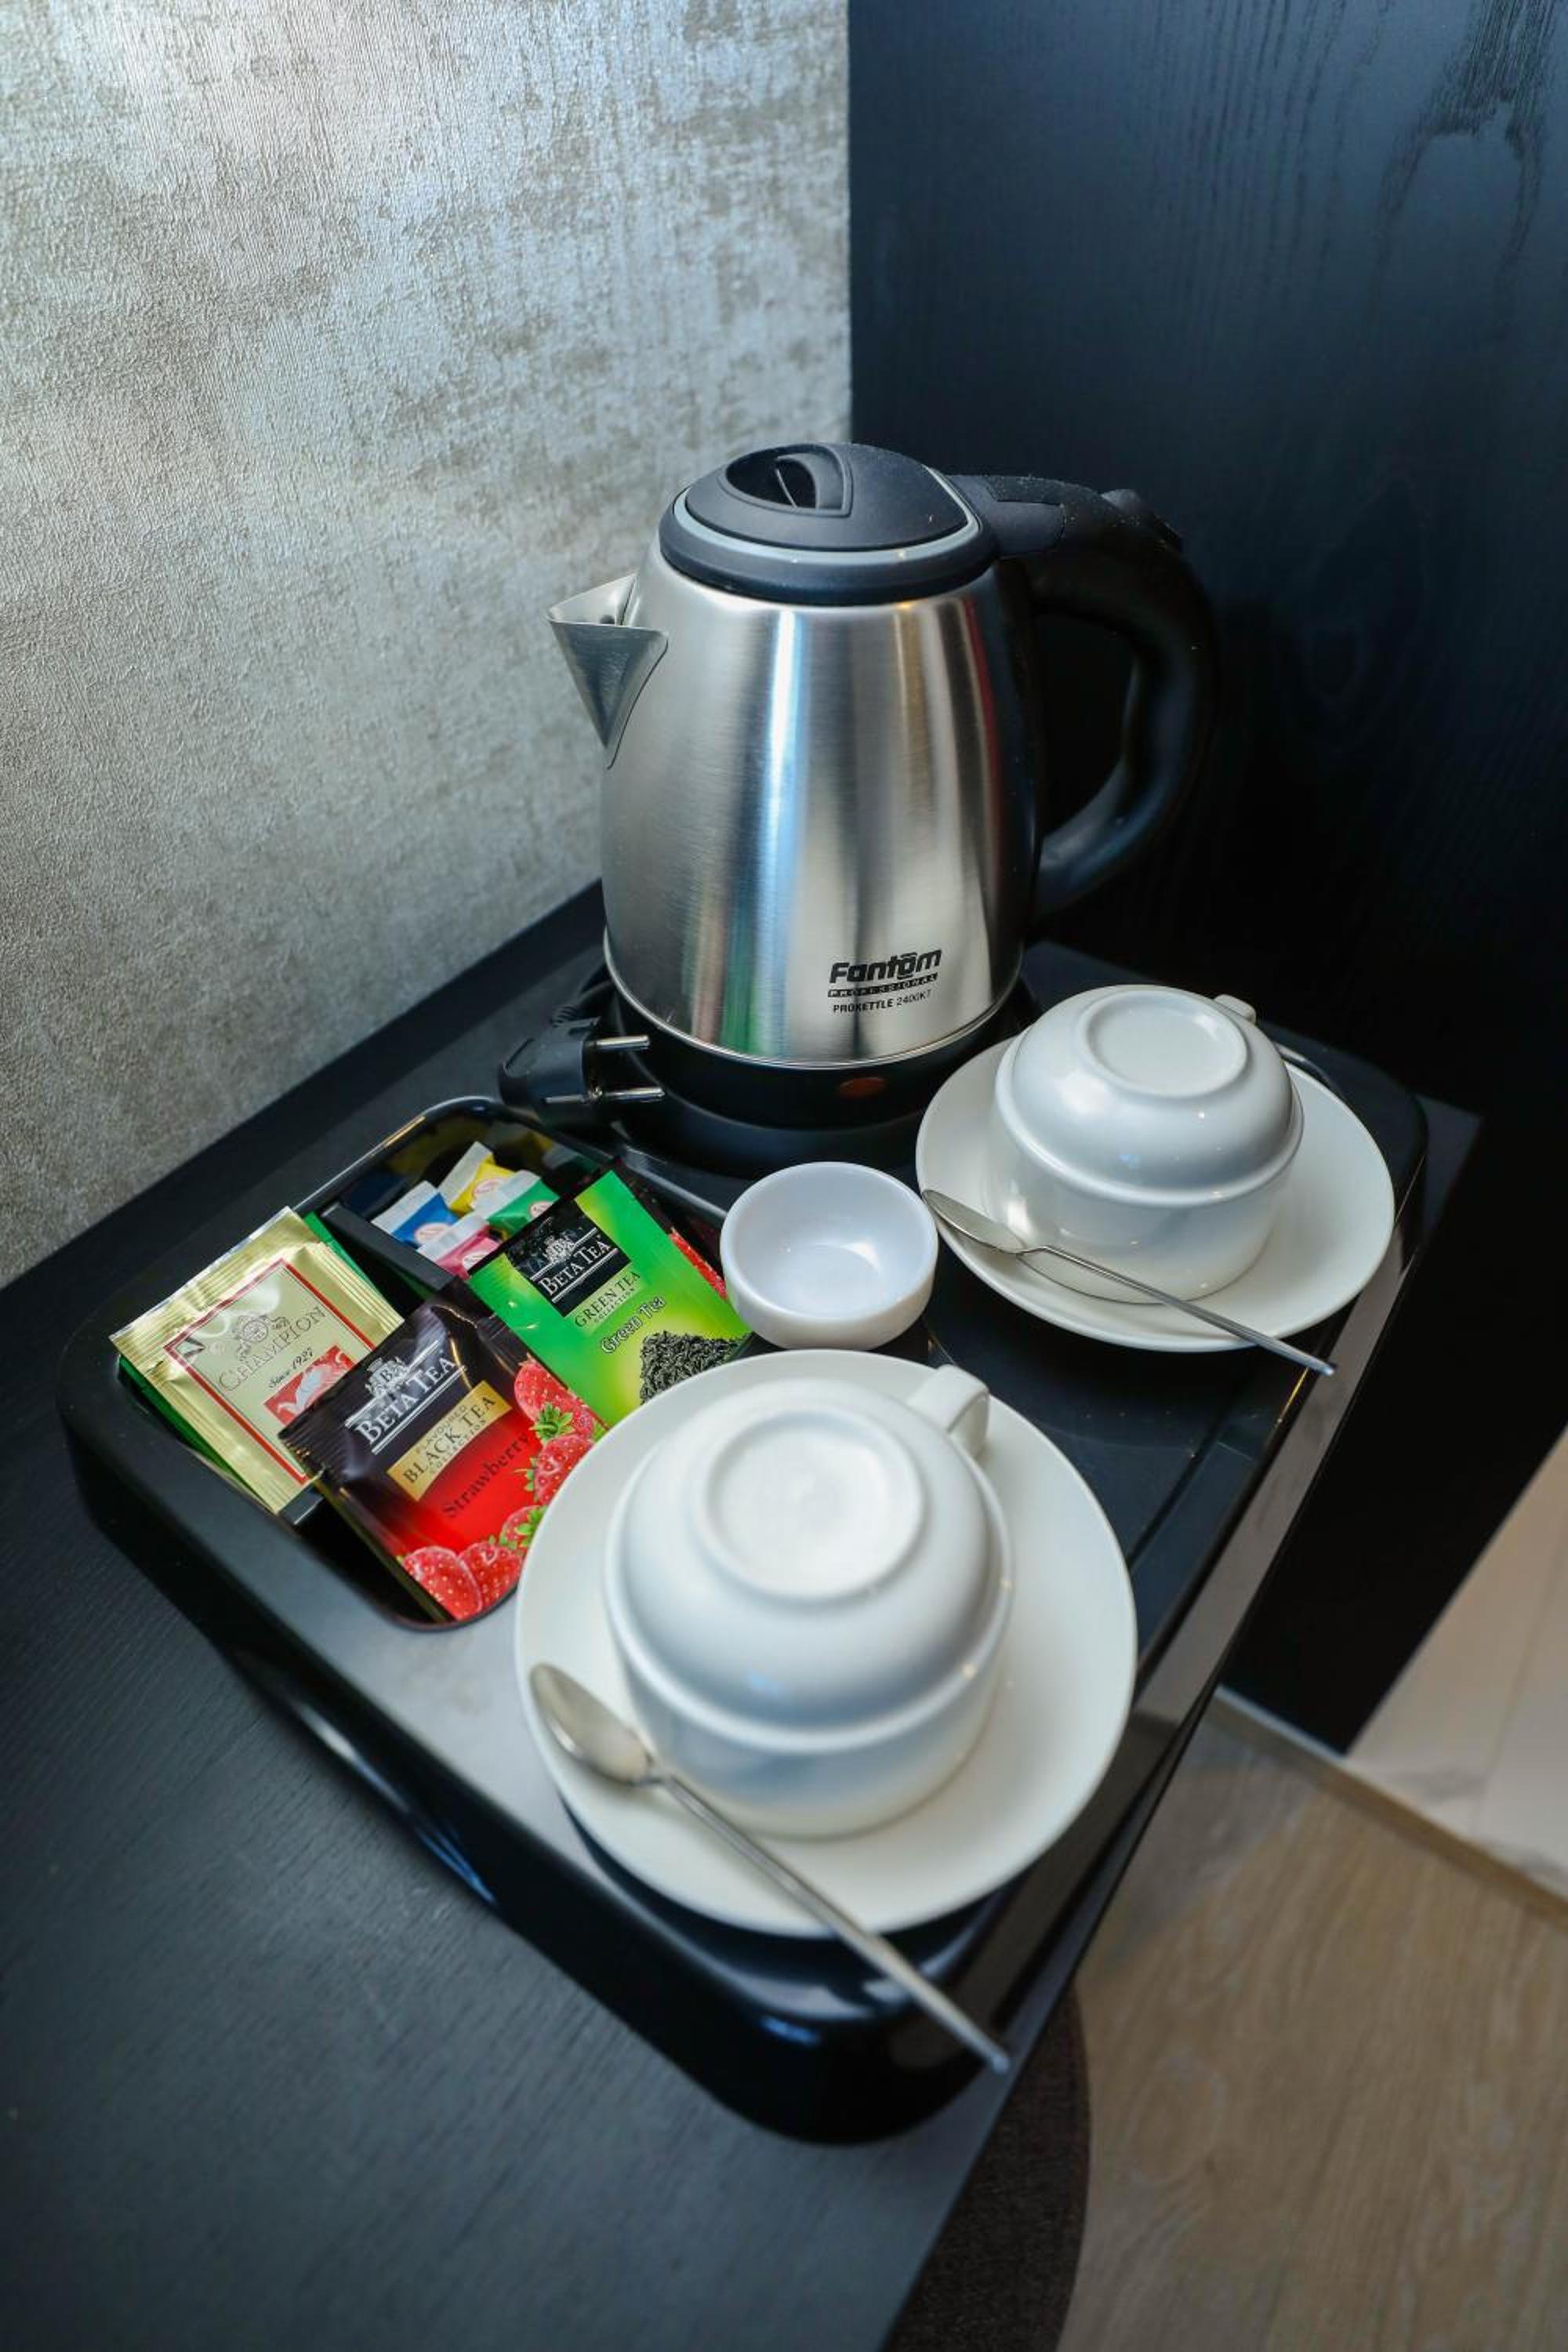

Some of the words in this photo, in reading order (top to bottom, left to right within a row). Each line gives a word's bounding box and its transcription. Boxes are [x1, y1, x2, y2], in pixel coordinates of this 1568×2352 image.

[833, 998, 894, 1013] PROKETTLE
[538, 1262, 584, 1295] BETA
[573, 1240, 612, 1265] TEA
[574, 1288, 618, 1327] GREEN
[614, 1271, 641, 1292] TEA
[601, 1316, 644, 1354] Green
[637, 1295, 666, 1319] Tea
[219, 1305, 326, 1391] CHAMPION
[292, 1346, 314, 1370] 1927
[354, 1393, 419, 1445] BETA
[405, 1356, 457, 1393] TEA
[402, 1428, 461, 1483] BLACK
[458, 1396, 496, 1427] TEA
[442, 1433, 530, 1519] Strawberry
